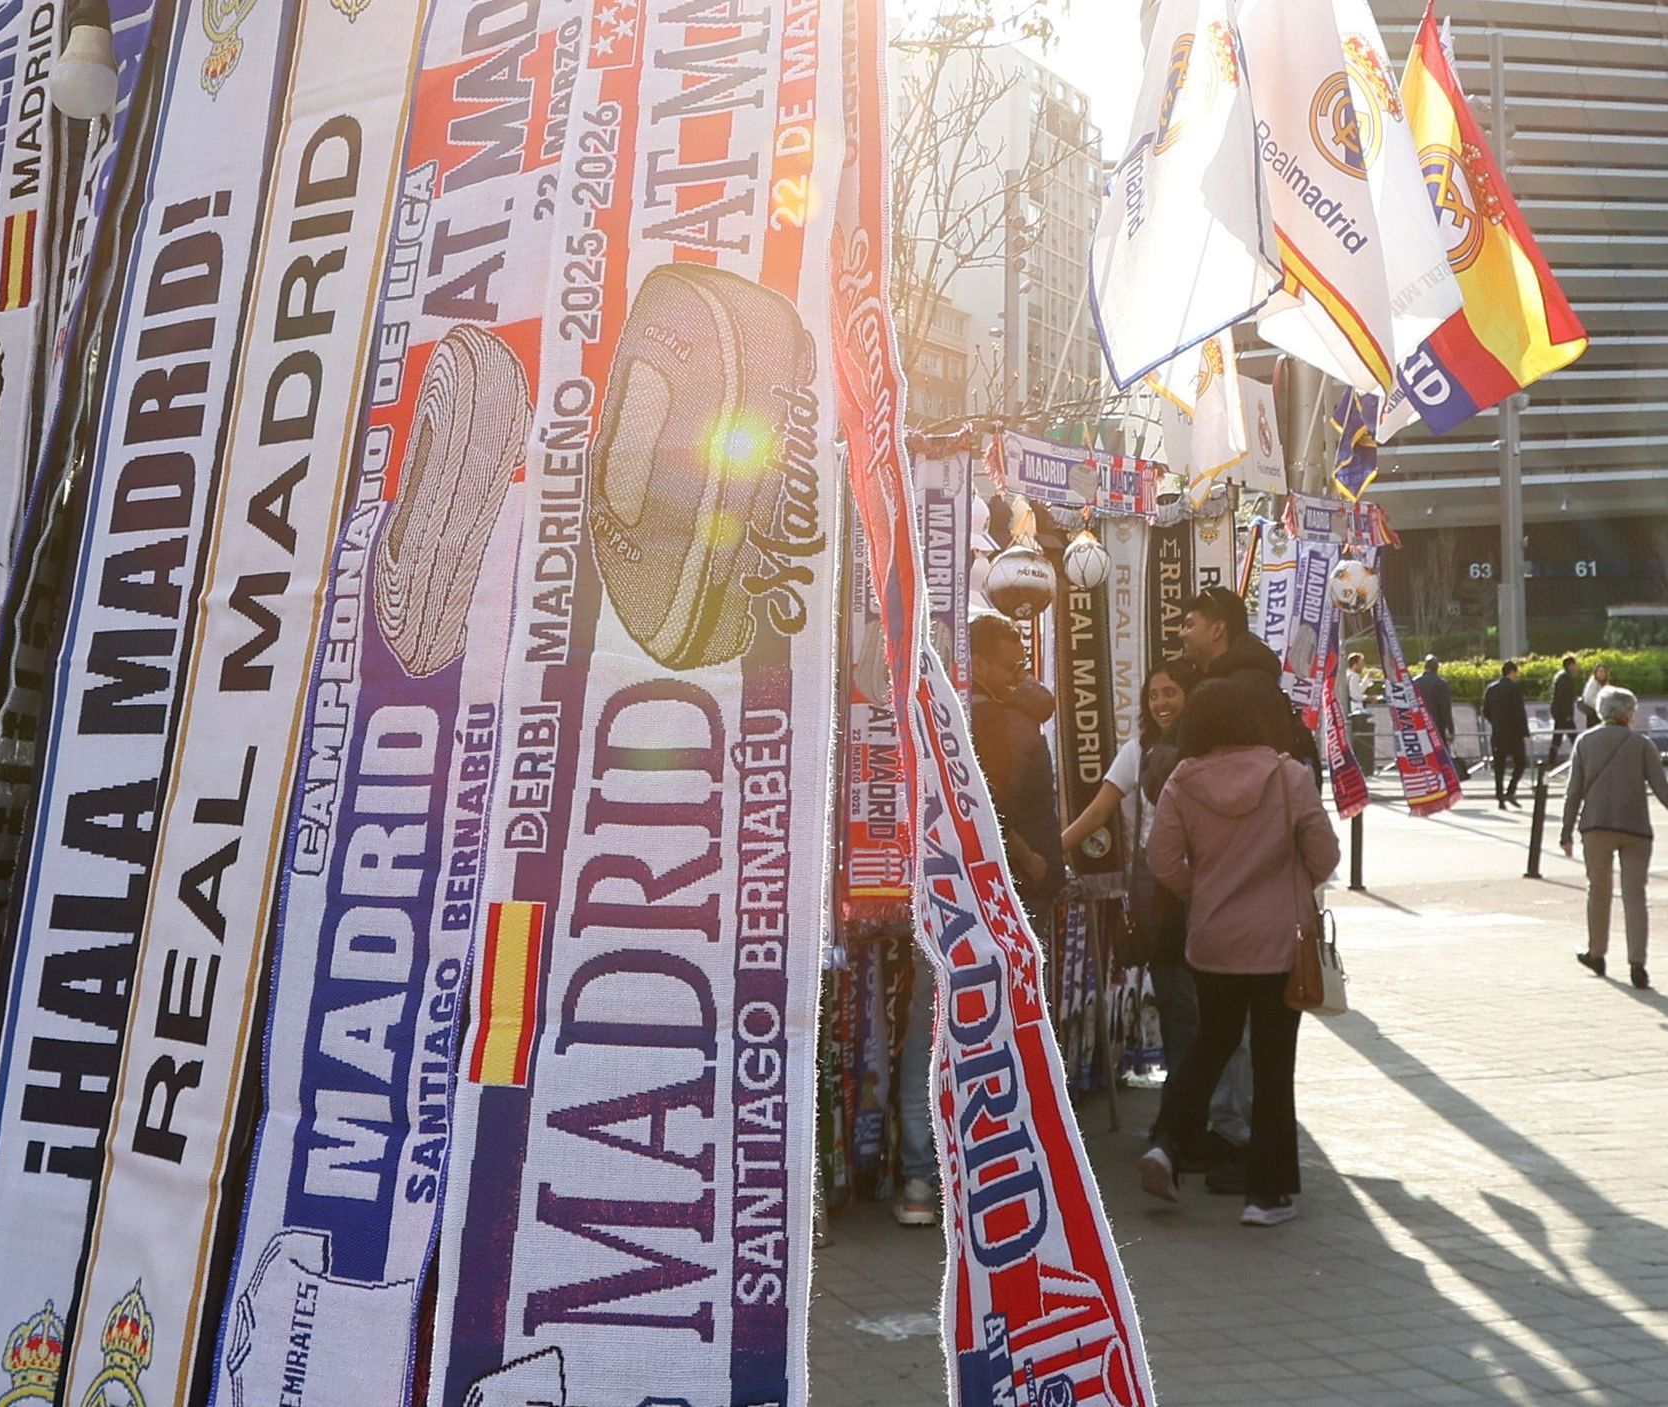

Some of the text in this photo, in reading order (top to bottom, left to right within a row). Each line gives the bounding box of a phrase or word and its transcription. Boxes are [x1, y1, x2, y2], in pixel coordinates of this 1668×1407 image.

[10, 2, 56, 201] MADRID
[541, 20, 583, 166] MARZO
[774, 98, 816, 162] DE
[533, 172, 562, 222] 22
[641, 145, 760, 254] AT
[770, 175, 807, 233] 22
[1254, 119, 1369, 256] Realmadrid
[421, 197, 514, 323] AT.
[77, 189, 232, 736] MADRID!
[290, 158, 438, 877] CAMPEONATO DE LIGA
[504, 98, 623, 853] DERBI MADRILEÑO 2025-2026
[1024, 453, 1068, 487] MADRID
[927, 502, 953, 614] MADRID
[1115, 564, 1131, 650] REAL
[1160, 561, 1182, 642] REAL
[1265, 578, 1288, 643] REAL
[1302, 557, 1328, 624] MADRID
[1469, 562, 1493, 580] 63
[1574, 560, 1598, 578] 61
[132, 113, 364, 1165] REAL MADRID
[1073, 658, 1103, 785] MADRID
[867, 743, 899, 840] MADRID
[303, 703, 442, 1202] MADRID
[405, 701, 497, 1204] SANTIAGO BERNABÉU
[524, 678, 728, 1343] MADRID
[731, 705, 790, 1306] SANTIAGO BERNABÉU
[922, 788, 1050, 1269] MADRID
[278, 1281, 320, 1407] EMIRATES
